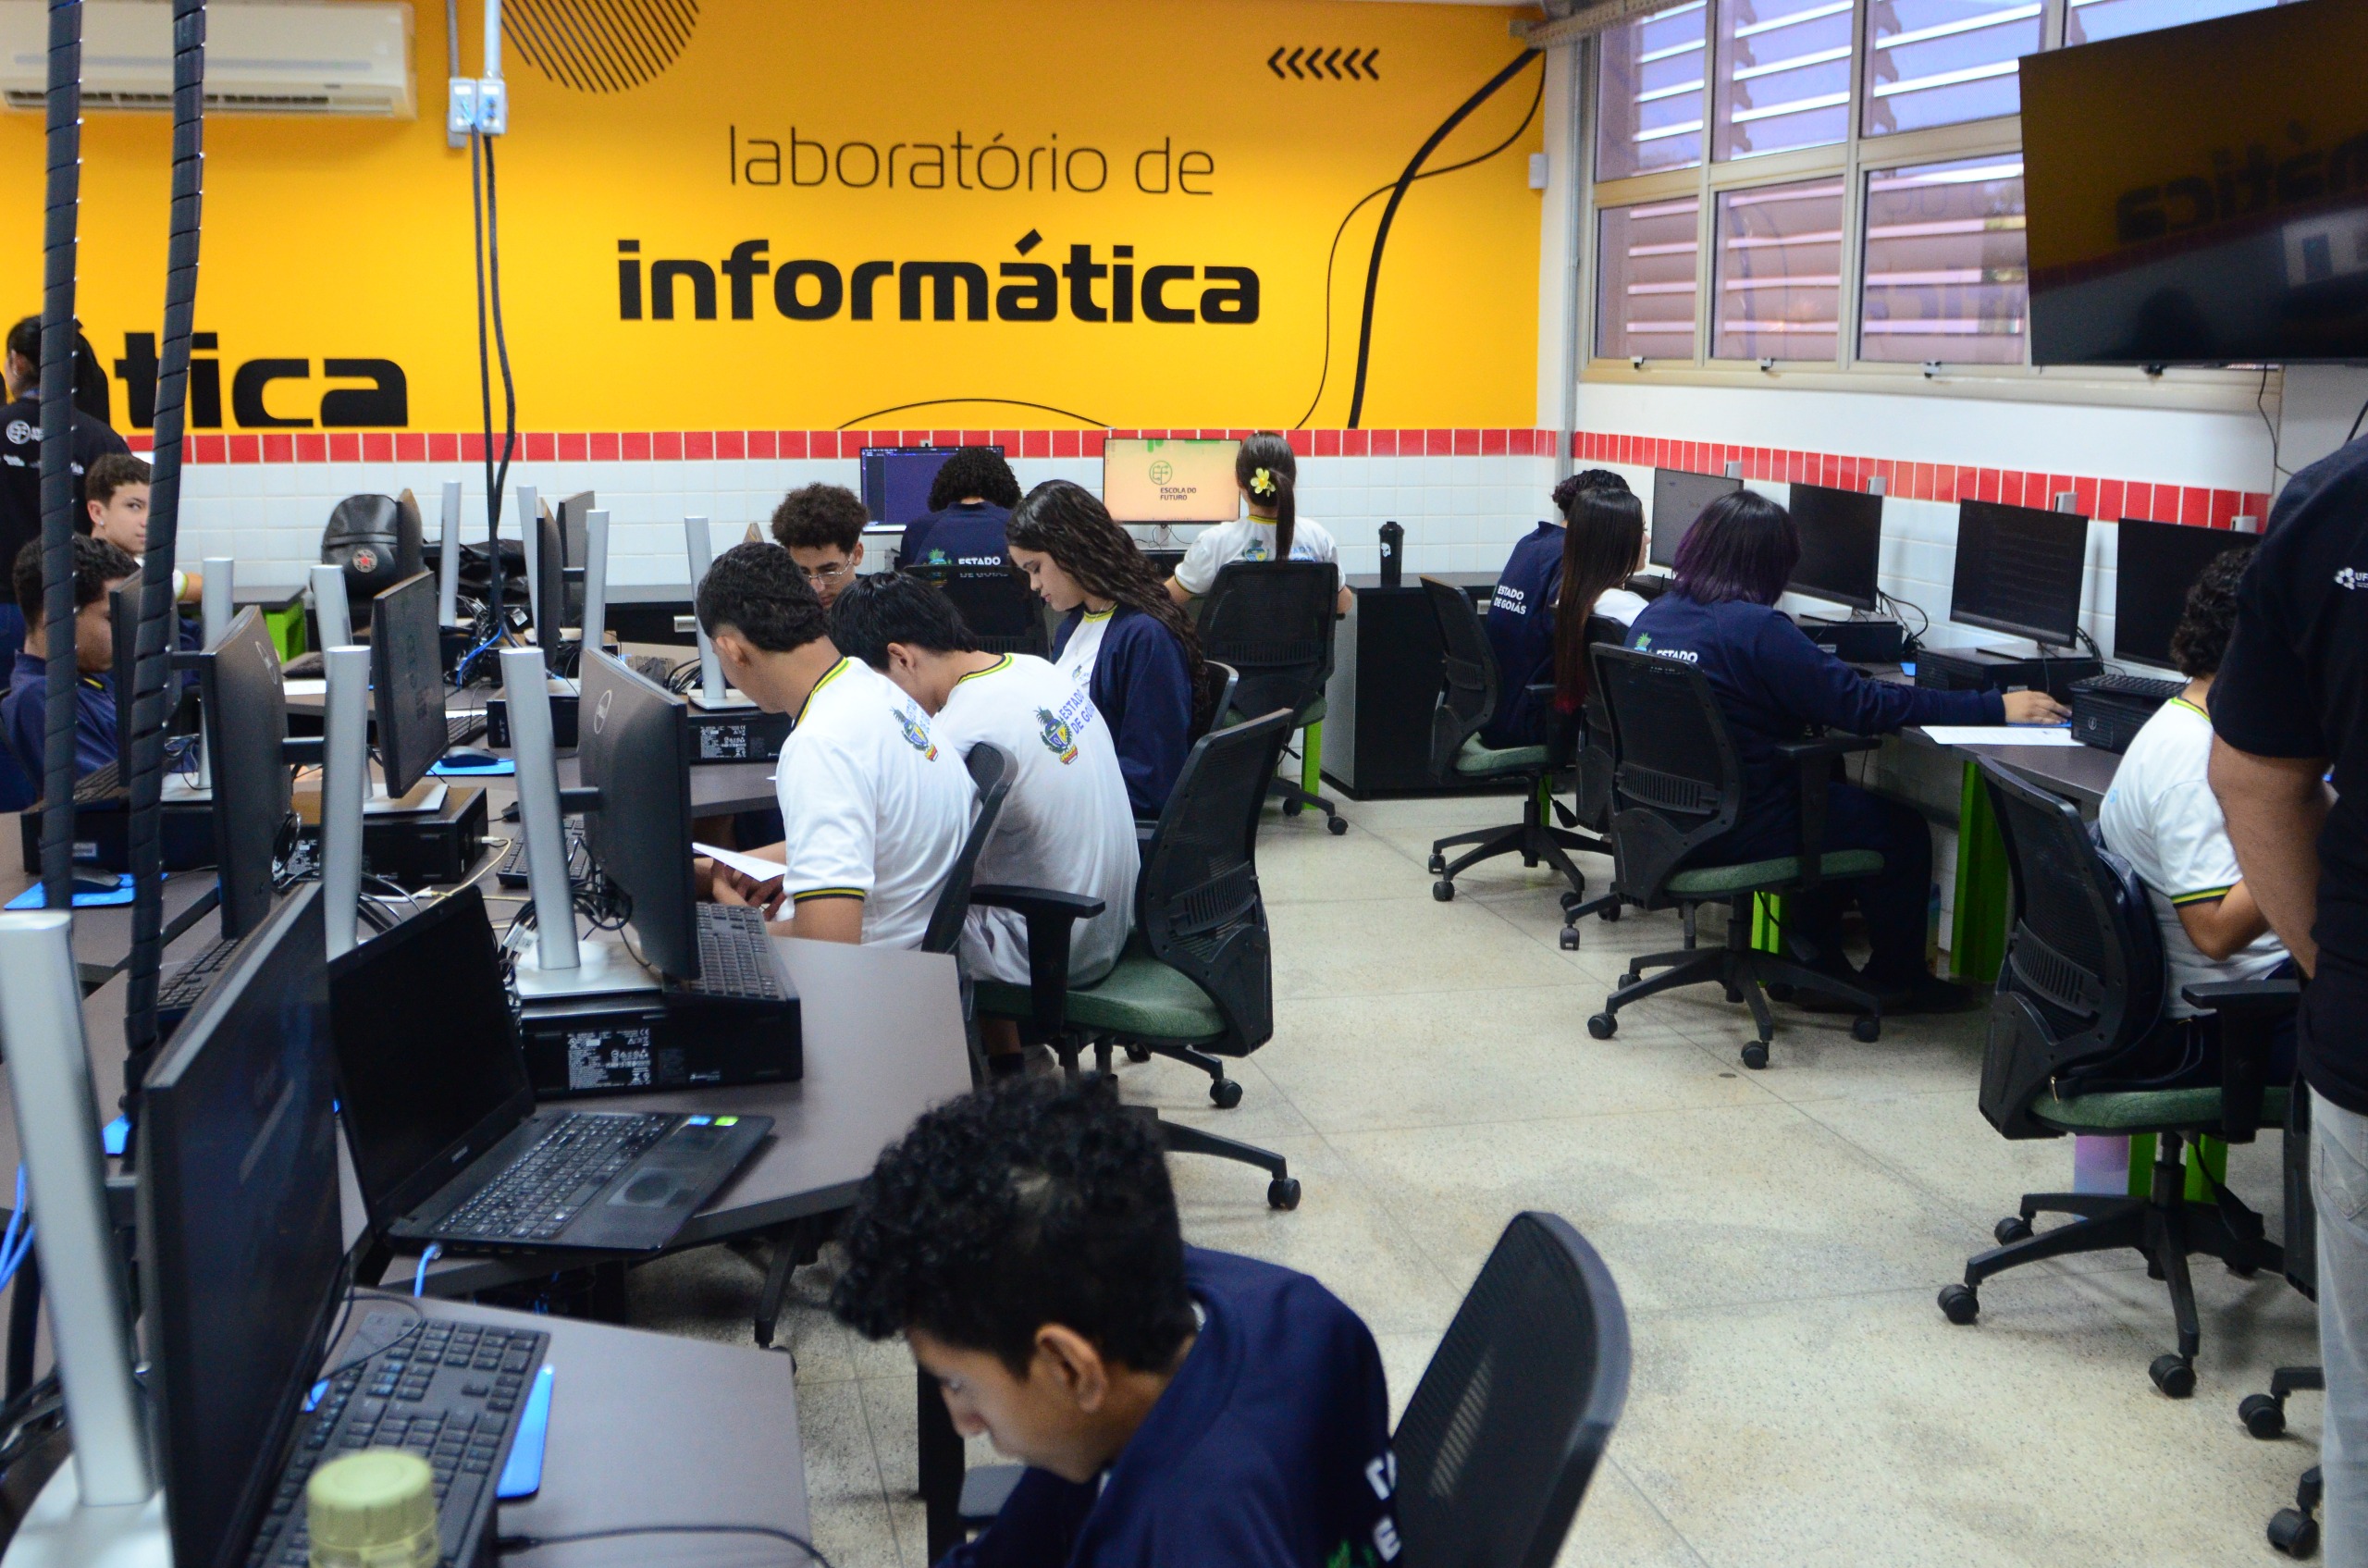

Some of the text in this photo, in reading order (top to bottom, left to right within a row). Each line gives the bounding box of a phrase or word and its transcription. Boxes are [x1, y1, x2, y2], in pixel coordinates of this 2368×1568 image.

[730, 125, 1215, 196] laboratório de
[617, 228, 1261, 325] informática
[958, 556, 1002, 566] ESTADO
[1497, 585, 1524, 601] ESTADO
[1493, 597, 1527, 615] DE GOIÁS
[1070, 717, 1085, 735] DE
